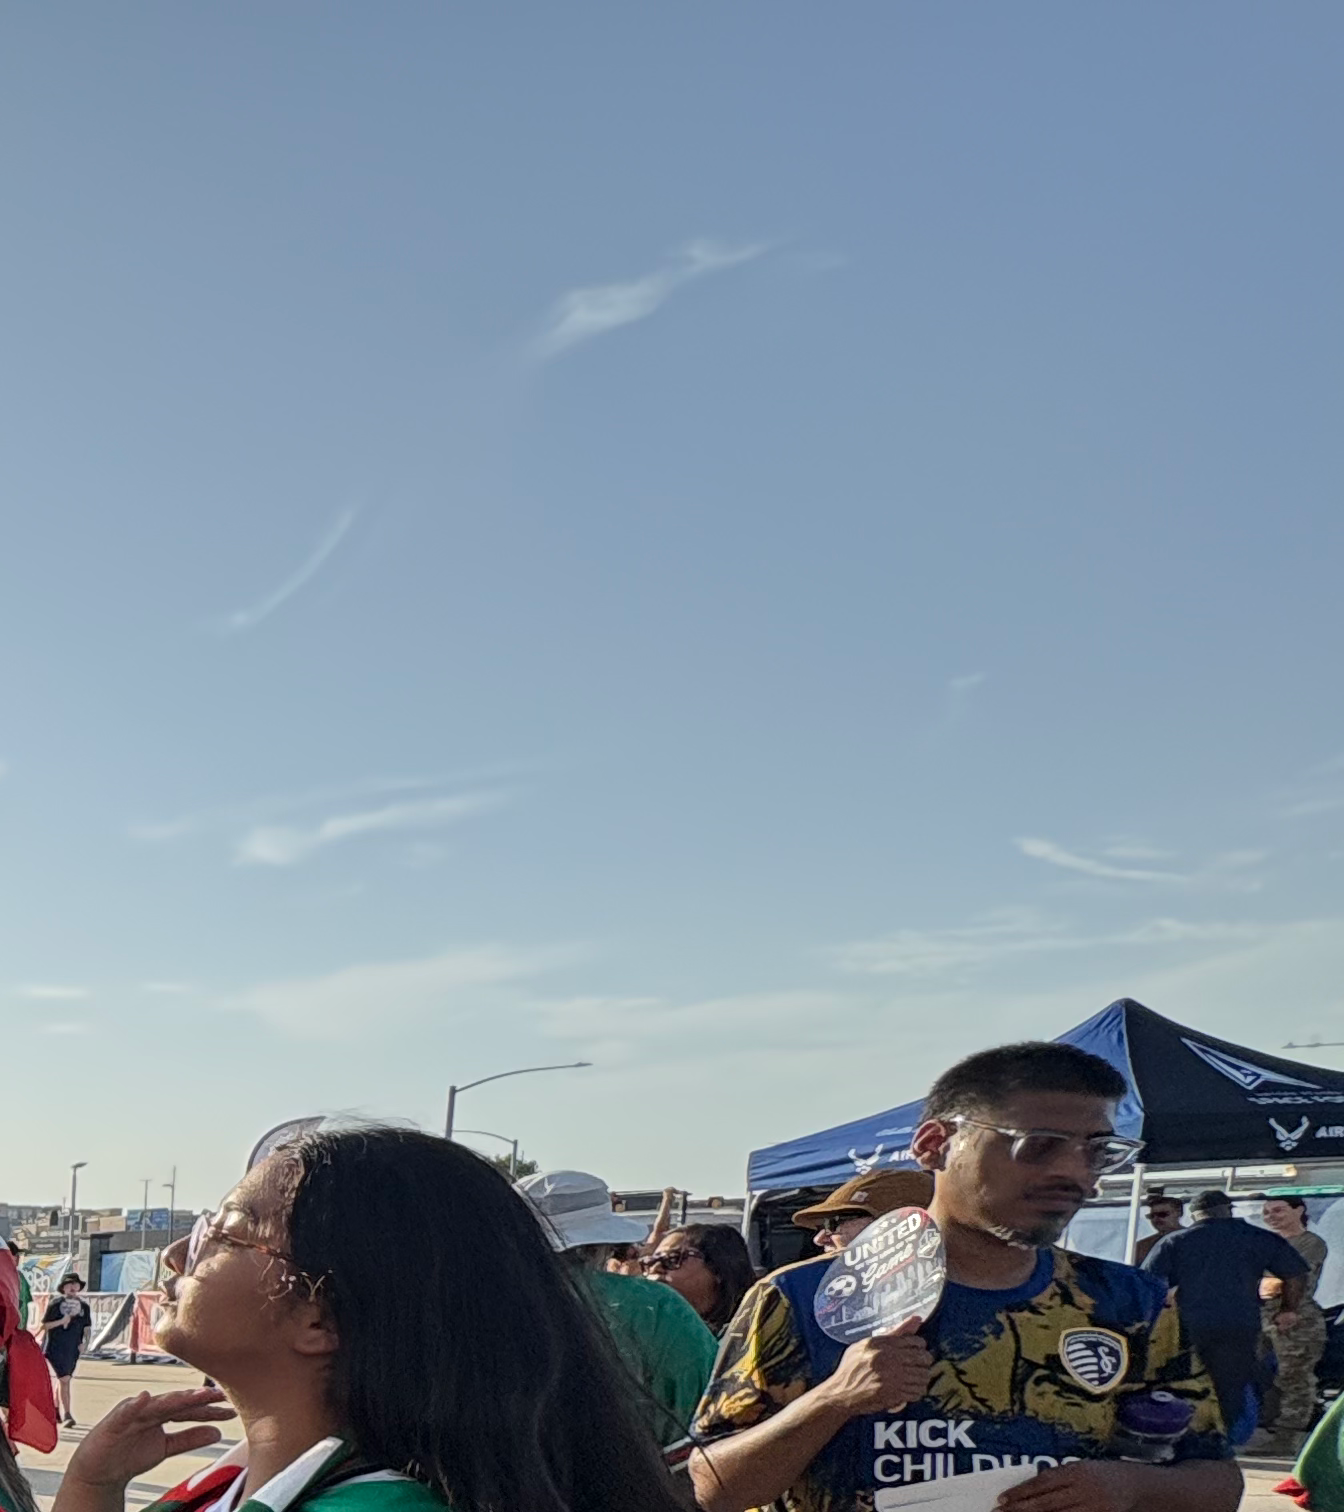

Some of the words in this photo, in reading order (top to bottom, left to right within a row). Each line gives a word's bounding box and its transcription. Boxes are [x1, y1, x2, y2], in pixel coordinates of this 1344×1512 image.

[844, 1213, 921, 1266] UNITED
[874, 1419, 977, 1450] KICK
[874, 1453, 1082, 1483] CHILD
